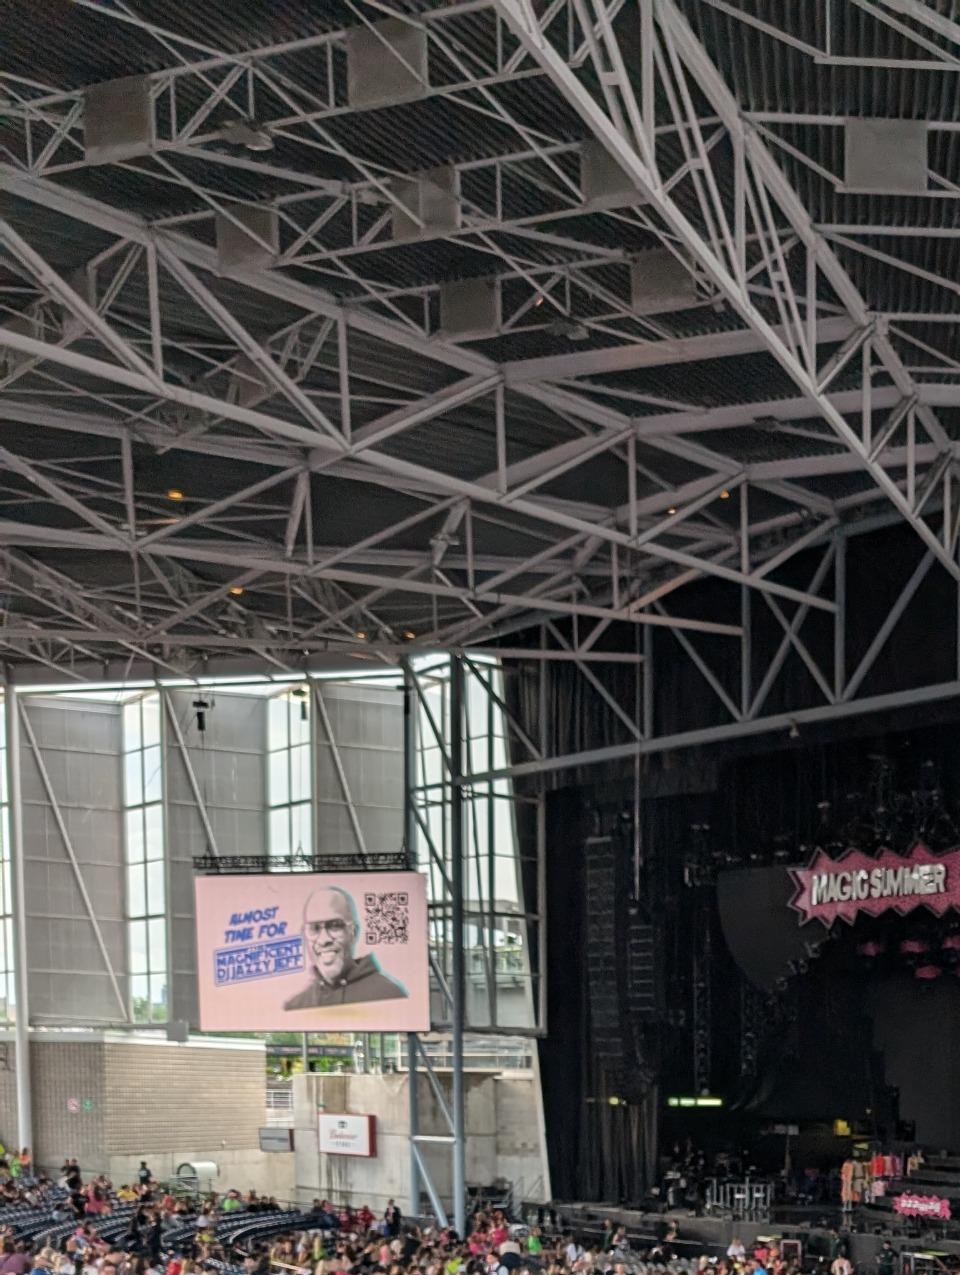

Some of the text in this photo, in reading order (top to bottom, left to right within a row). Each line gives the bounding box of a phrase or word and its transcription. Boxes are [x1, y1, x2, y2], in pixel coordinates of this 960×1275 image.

[811, 863, 946, 905] MAGIC SUMMER
[229, 906, 279, 926] ALMOST
[224, 921, 288, 943] TIME FOR
[217, 943, 303, 966] MAGNIFICENT
[231, 960, 270, 980] JAZZY
[273, 954, 303, 973] JEFF
